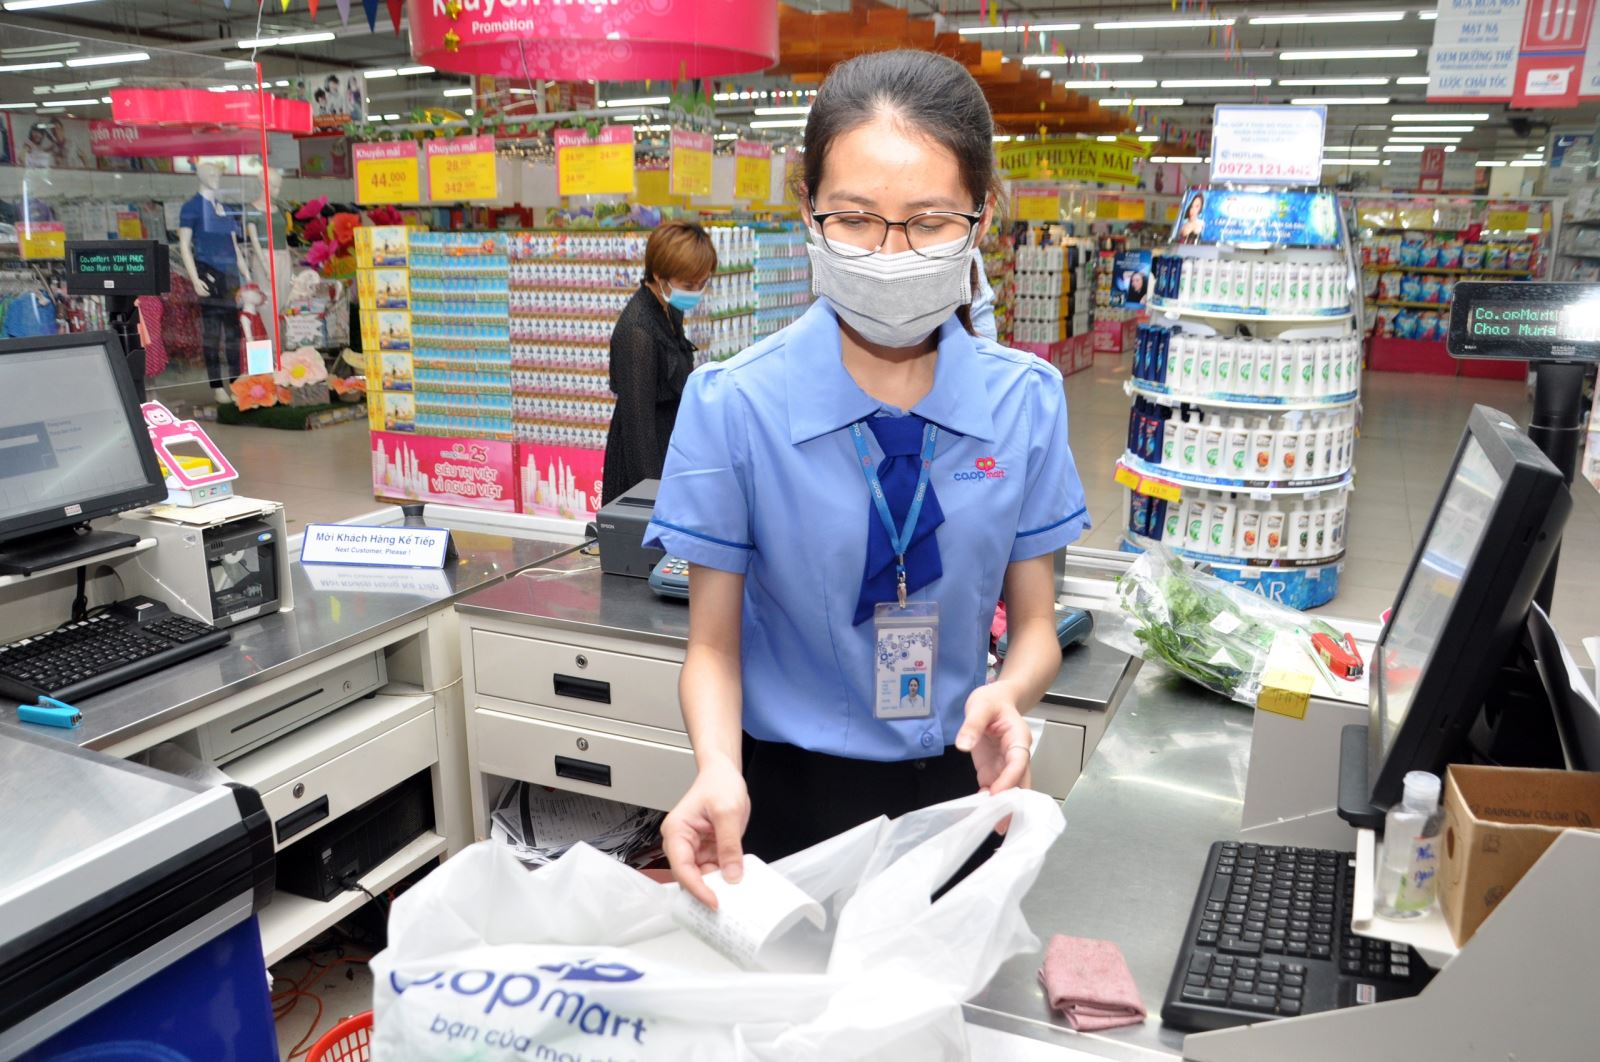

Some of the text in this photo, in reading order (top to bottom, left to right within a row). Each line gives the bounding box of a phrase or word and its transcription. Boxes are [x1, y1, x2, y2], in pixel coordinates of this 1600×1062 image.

[471, 19, 535, 35] Promotion
[1000, 152, 1031, 170] KHU
[1474, 322, 1510, 335] Chao
[316, 532, 334, 541] Mời
[336, 533, 367, 543] Khách
[369, 534, 396, 546] Hàng
[415, 535, 436, 548] Tiếp
[1484, 807, 1569, 820] RAINBOW COLOR
[430, 1013, 479, 1042] bạn
[484, 1029, 532, 1053] của
